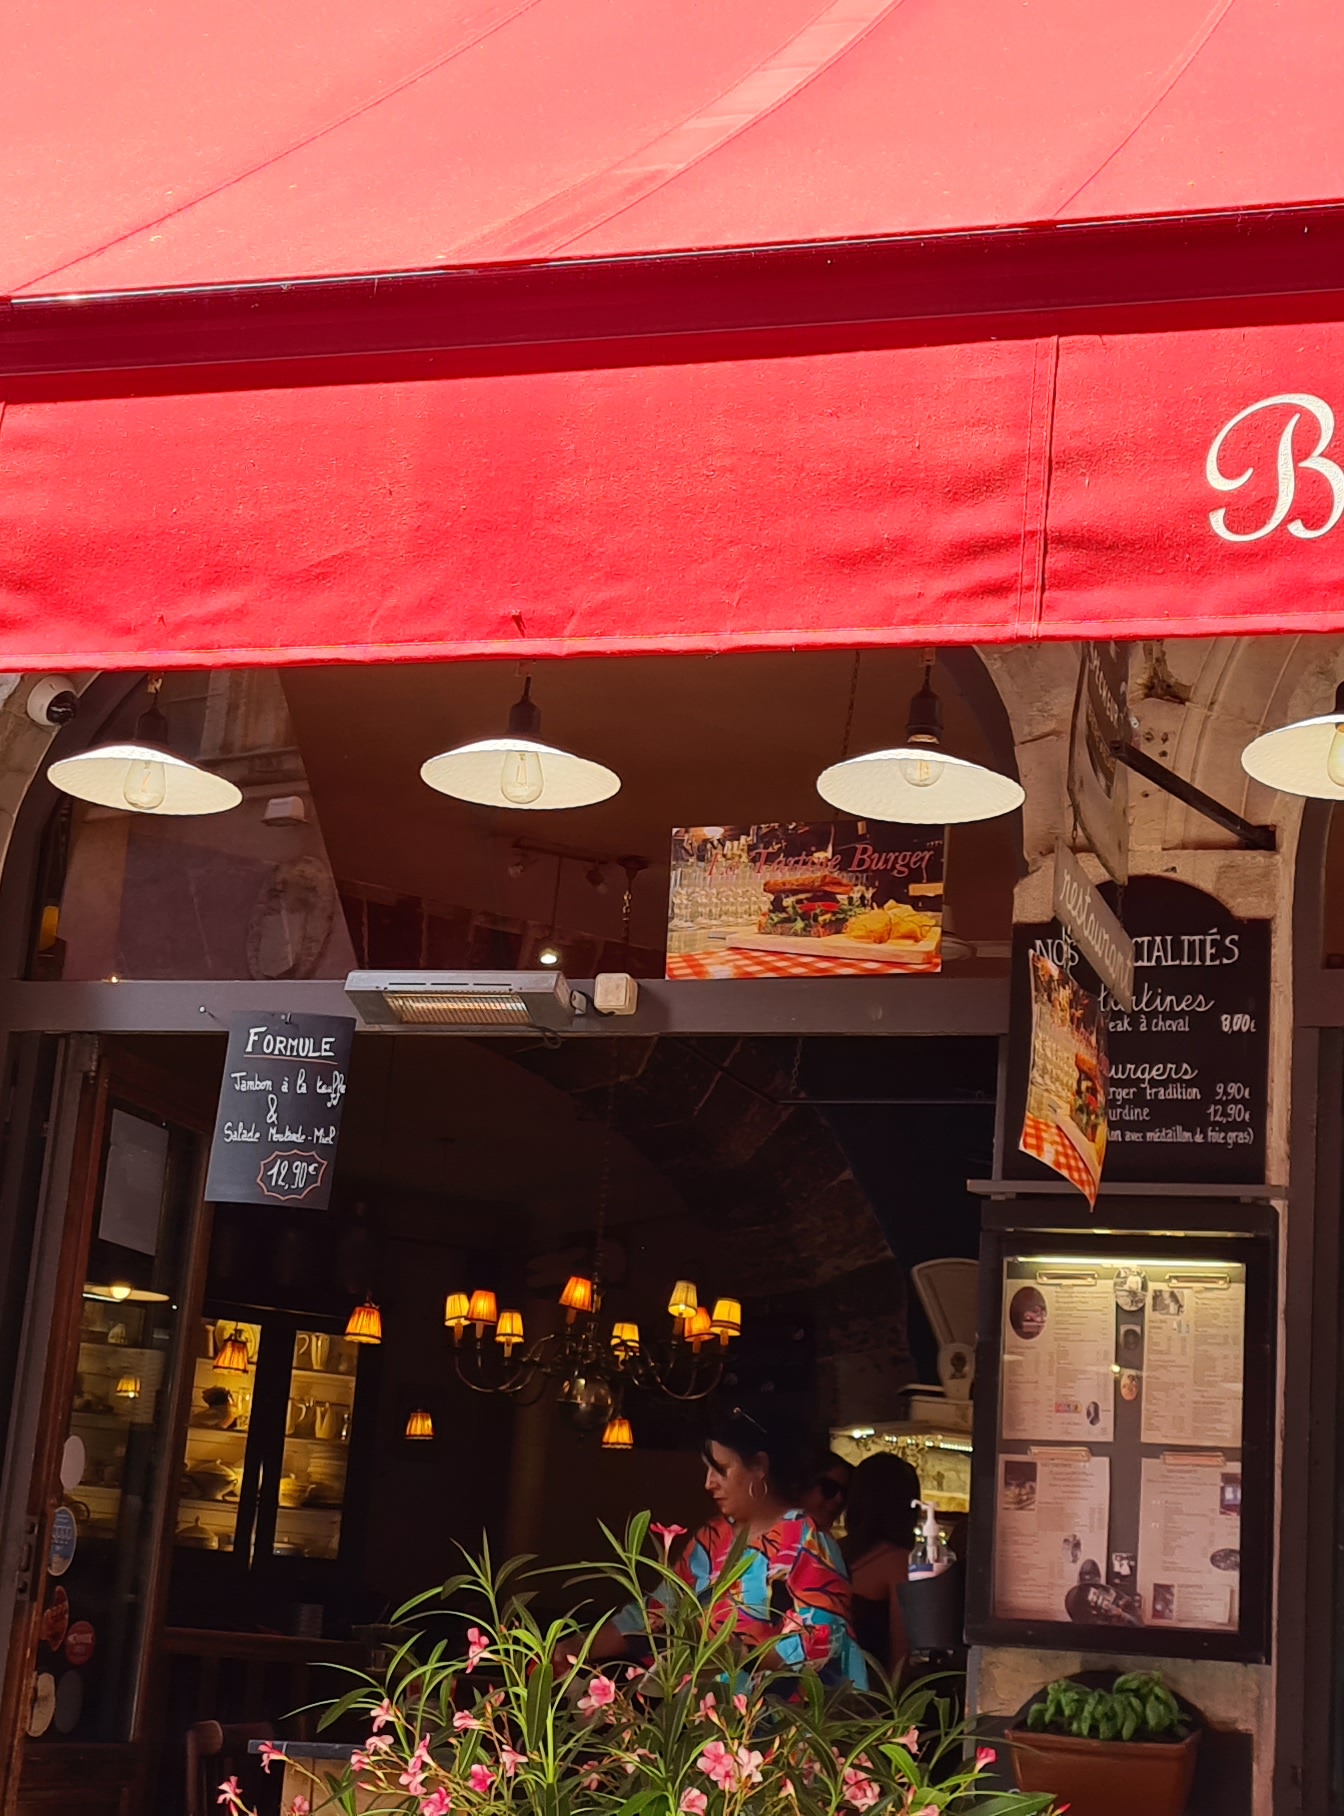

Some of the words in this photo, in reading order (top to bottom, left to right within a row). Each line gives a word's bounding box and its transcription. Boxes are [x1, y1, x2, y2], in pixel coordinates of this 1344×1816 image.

[848, 842, 934, 877] Burger
[1059, 869, 1132, 996] restaurant
[1108, 1015, 1133, 1032] eak
[1140, 1014, 1148, 1032] à
[1151, 1015, 1190, 1032] cheval
[231, 1071, 272, 1092] Jambon
[296, 1069, 307, 1094] la
[1109, 1062, 1198, 1087] urgers
[1108, 1086, 1137, 1105] rger
[1146, 1082, 1201, 1100] tradition
[267, 1094, 278, 1124] &
[1194, 1127, 1204, 1143] de
